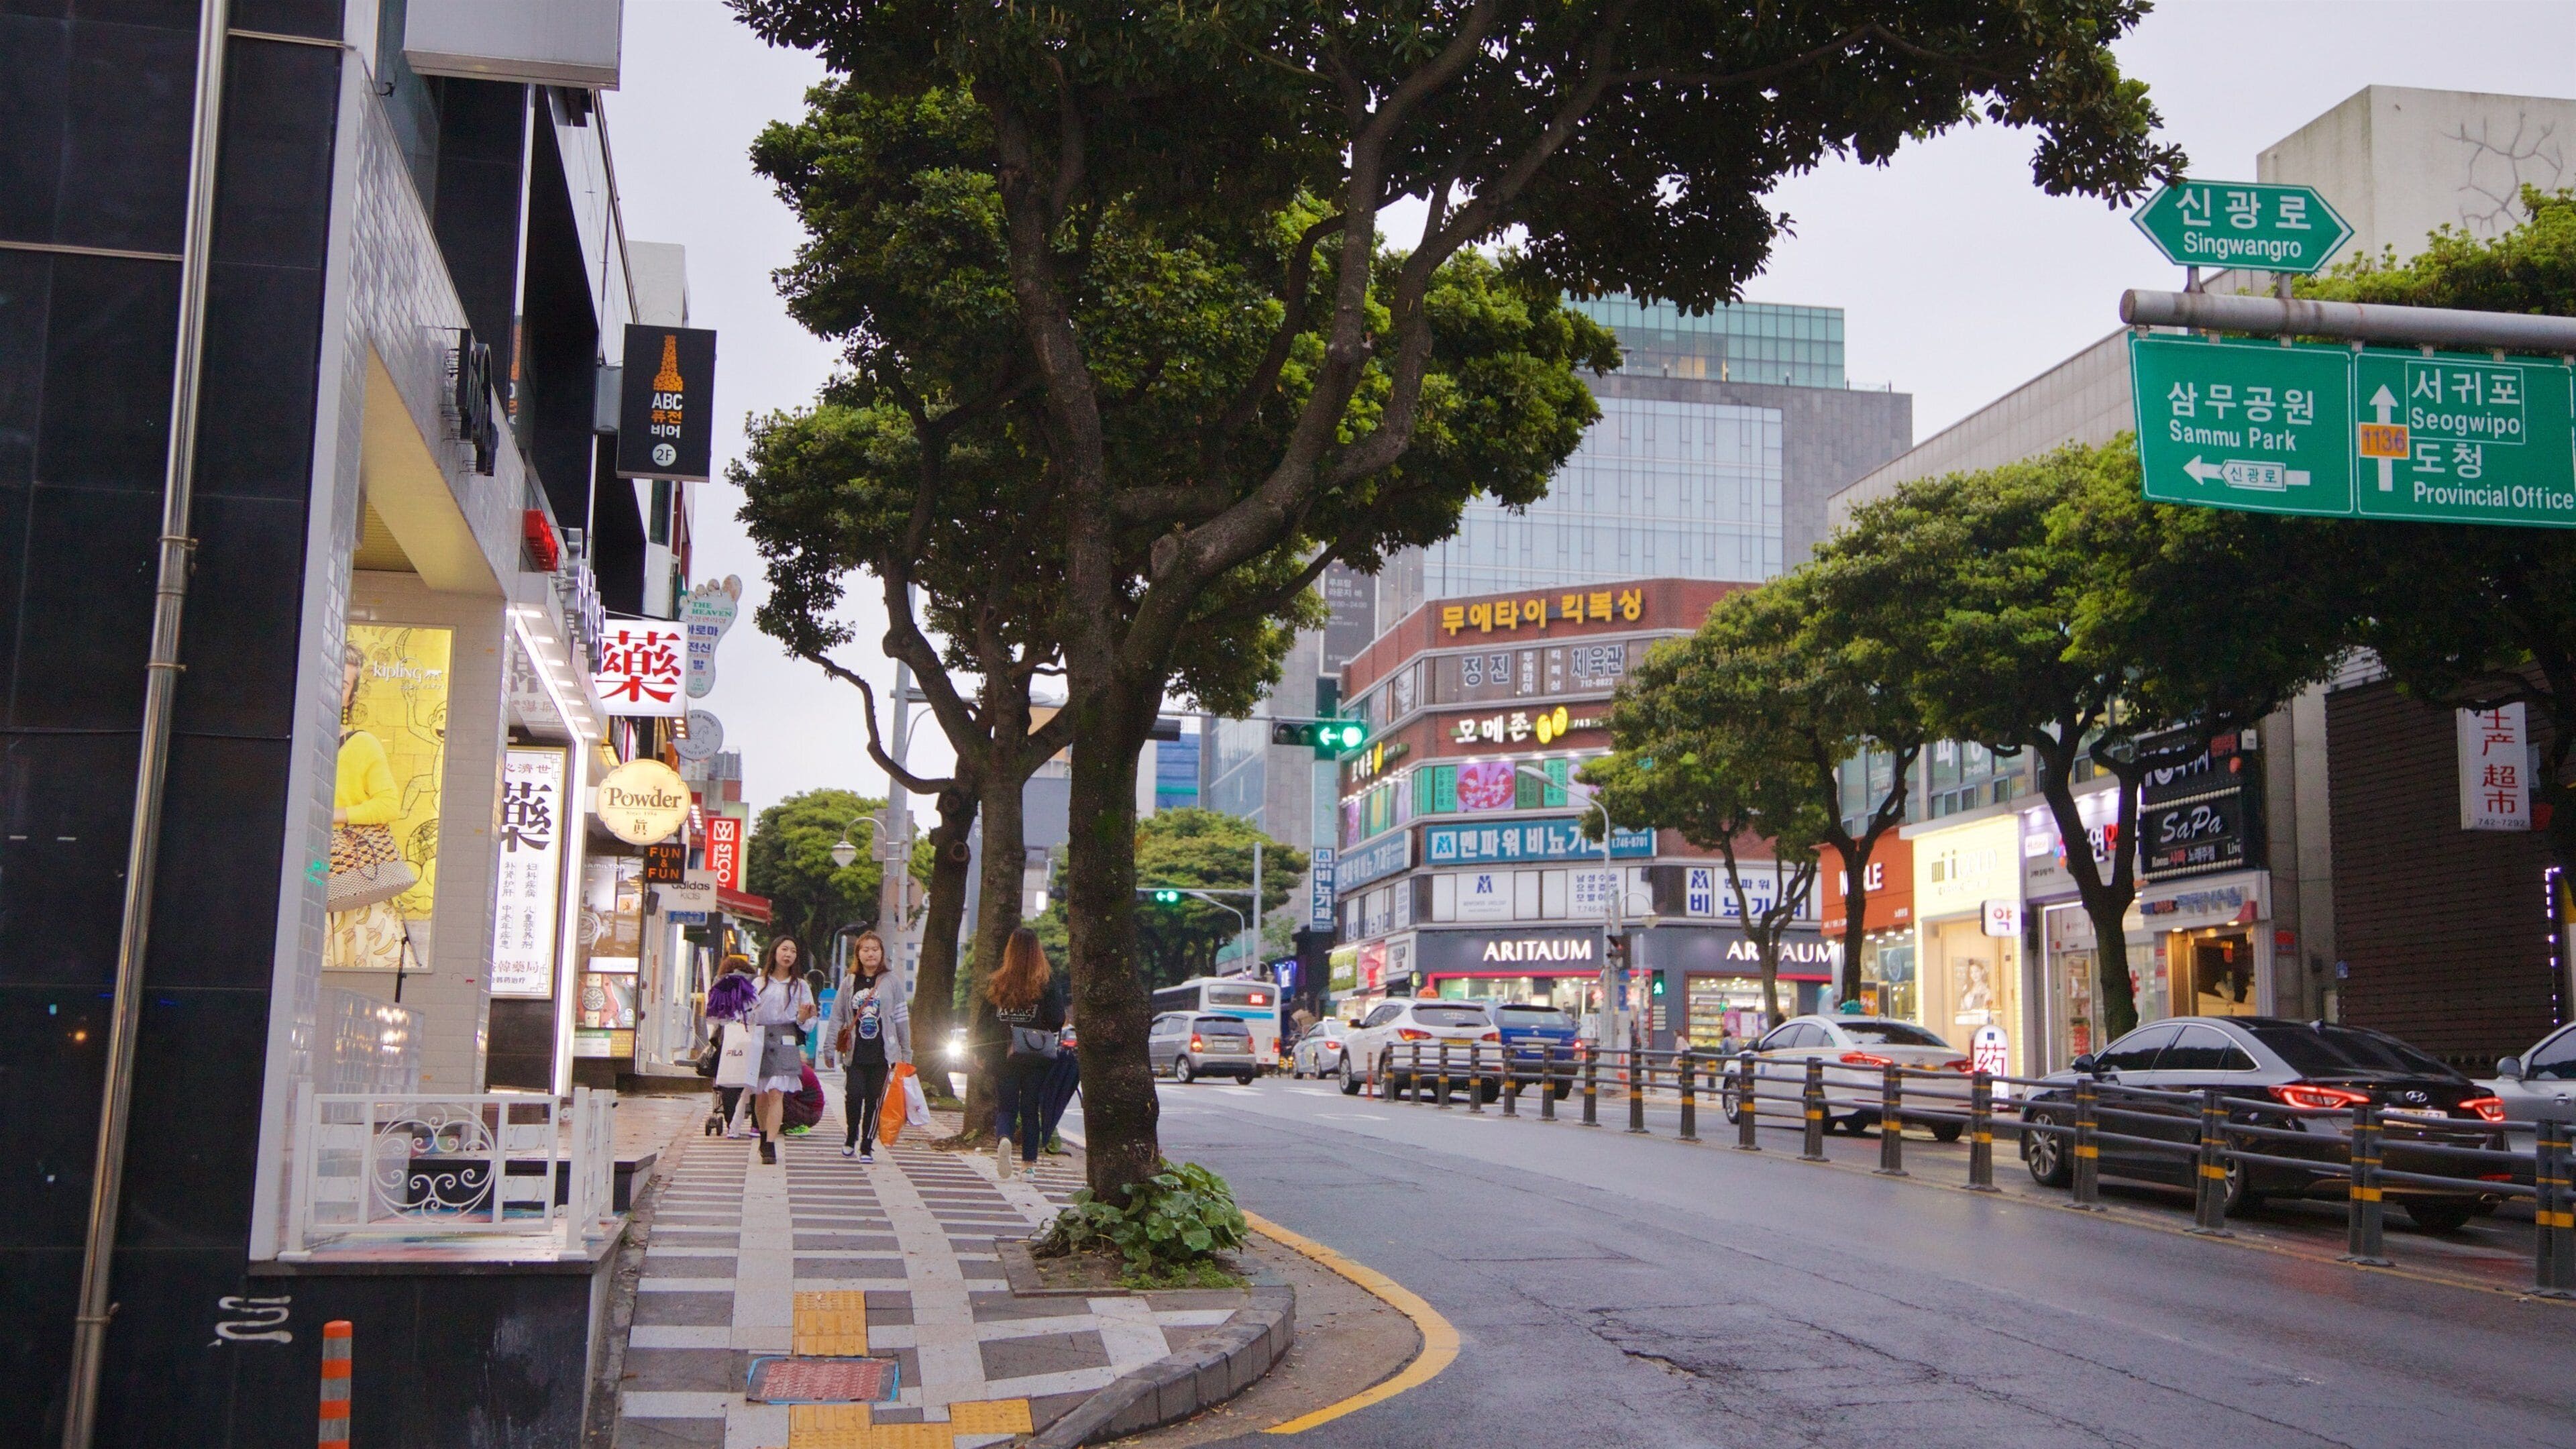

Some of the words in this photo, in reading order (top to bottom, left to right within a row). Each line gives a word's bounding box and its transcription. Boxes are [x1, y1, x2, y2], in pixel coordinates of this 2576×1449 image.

[2176, 187, 2312, 231] 신광로
[2184, 231, 2302, 260] Singwangro
[2412, 368, 2521, 406] 서귀포
[651, 393, 683, 411] ABC
[2167, 382, 2314, 426] 삼무공원
[651, 410, 682, 425] 퓨전
[2411, 407, 2520, 439] Seogwipo
[651, 424, 681, 439] 비어
[2169, 420, 2241, 449] Sammu
[2249, 429, 2296, 452] Park
[2363, 428, 2407, 453] 1136
[655, 449, 673, 461] 2F
[2412, 443, 2483, 479] 도청
[2231, 467, 2277, 483] 신광로
[2414, 480, 2509, 508] Provincial
[2512, 485, 2575, 510] Office
[692, 601, 712, 609] THE
[692, 608, 732, 617] HEAVEN
[1442, 599, 1547, 637] 무에타이
[1561, 588, 1642, 625] 킥복싱
[688, 641, 711, 653] 전신
[373, 659, 423, 684] kipling
[594, 629, 682, 704] 藥
[1462, 653, 1511, 686] 정진
[1570, 644, 1625, 679] 체육관
[2481, 708, 2518, 814] 土产超市
[604, 786, 682, 808] Powder
[2159, 805, 2224, 844] SaPa
[2477, 818, 2526, 827] 742-7292
[649, 847, 682, 859] FUN
[1460, 828, 1520, 859] 맨파워
[647, 867, 680, 879] FUN
[660, 859, 668, 868] &
[717, 843, 733, 883] STCO
[671, 880, 710, 890] adidas
[1839, 862, 1882, 897] NLE
[680, 890, 702, 900] kids
[1314, 869, 1332, 920] 비뇨기과
[1483, 940, 1593, 962] ARITAUM
[1726, 941, 1833, 963] ARAUM
